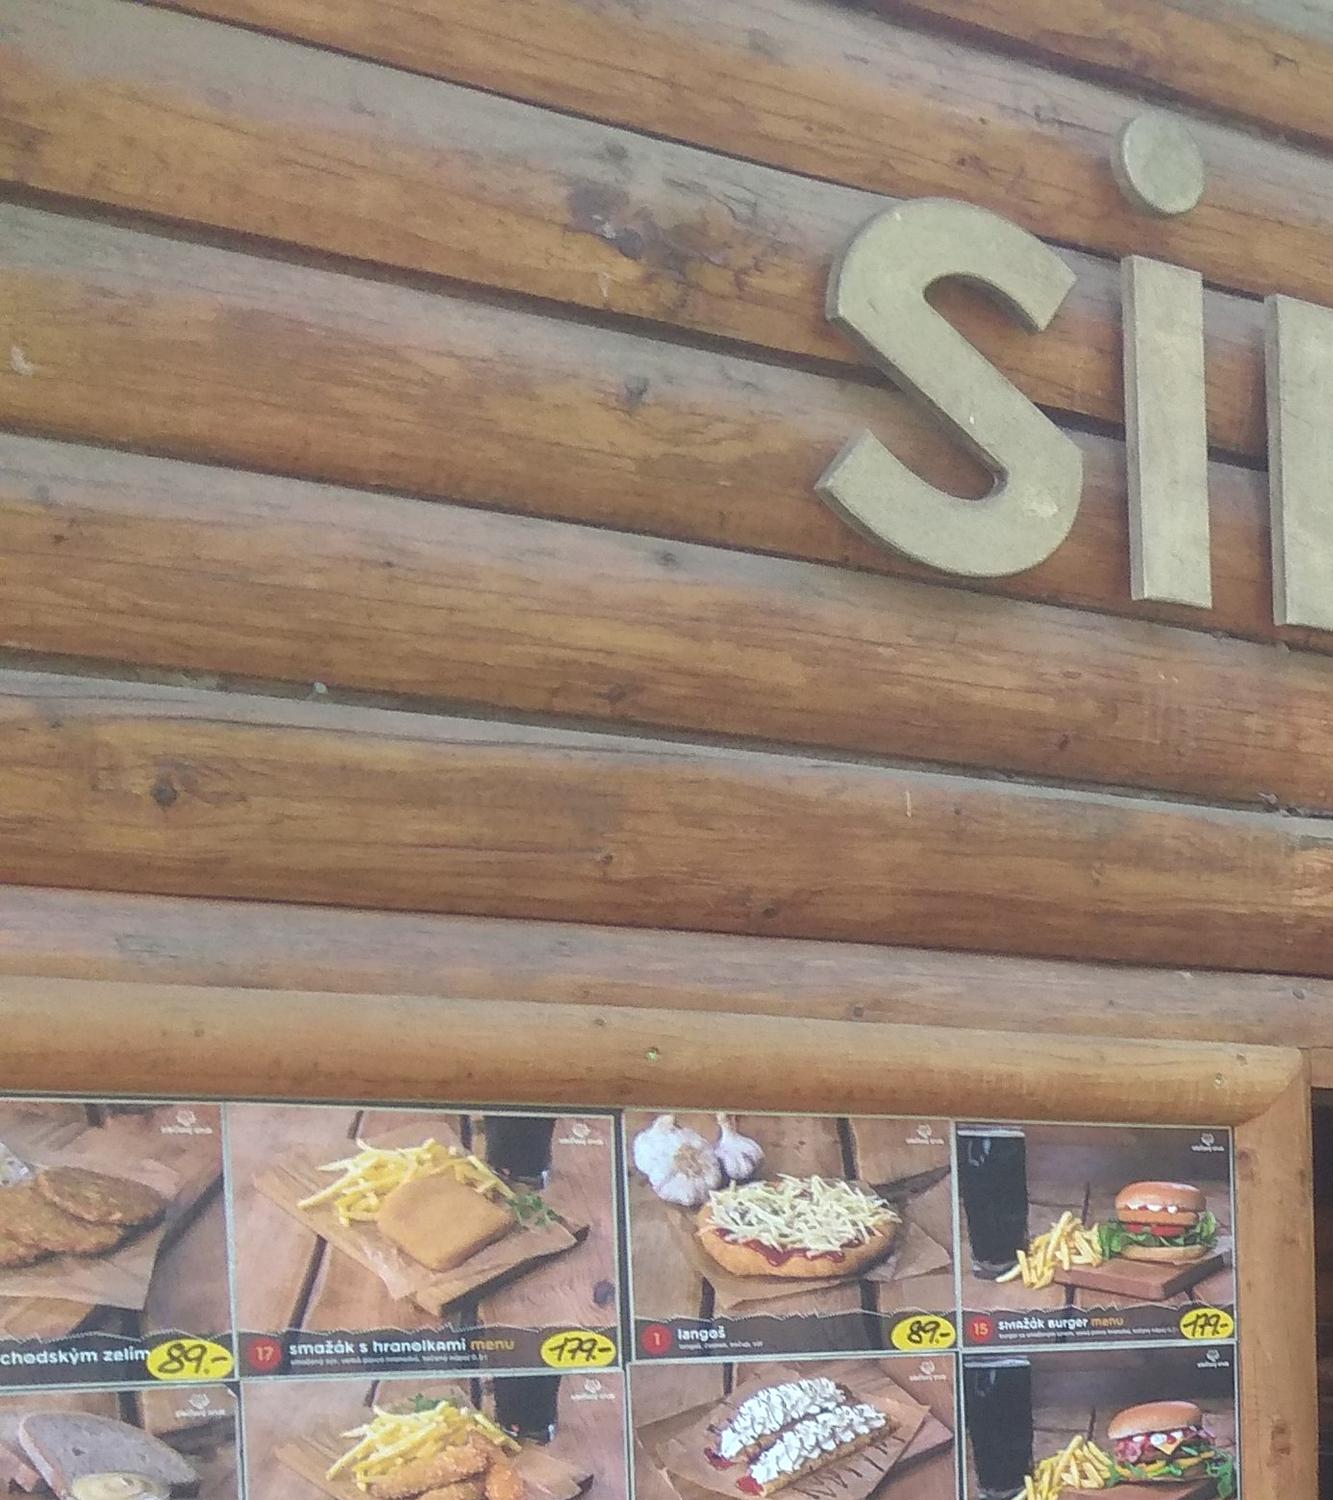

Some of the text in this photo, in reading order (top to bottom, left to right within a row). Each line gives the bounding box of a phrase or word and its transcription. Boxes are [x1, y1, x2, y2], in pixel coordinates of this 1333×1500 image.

[1092, 1316, 1124, 1327] menu
[677, 1324, 726, 1344] langoš
[360, 1342, 369, 1354] s
[470, 1338, 516, 1352] menu
